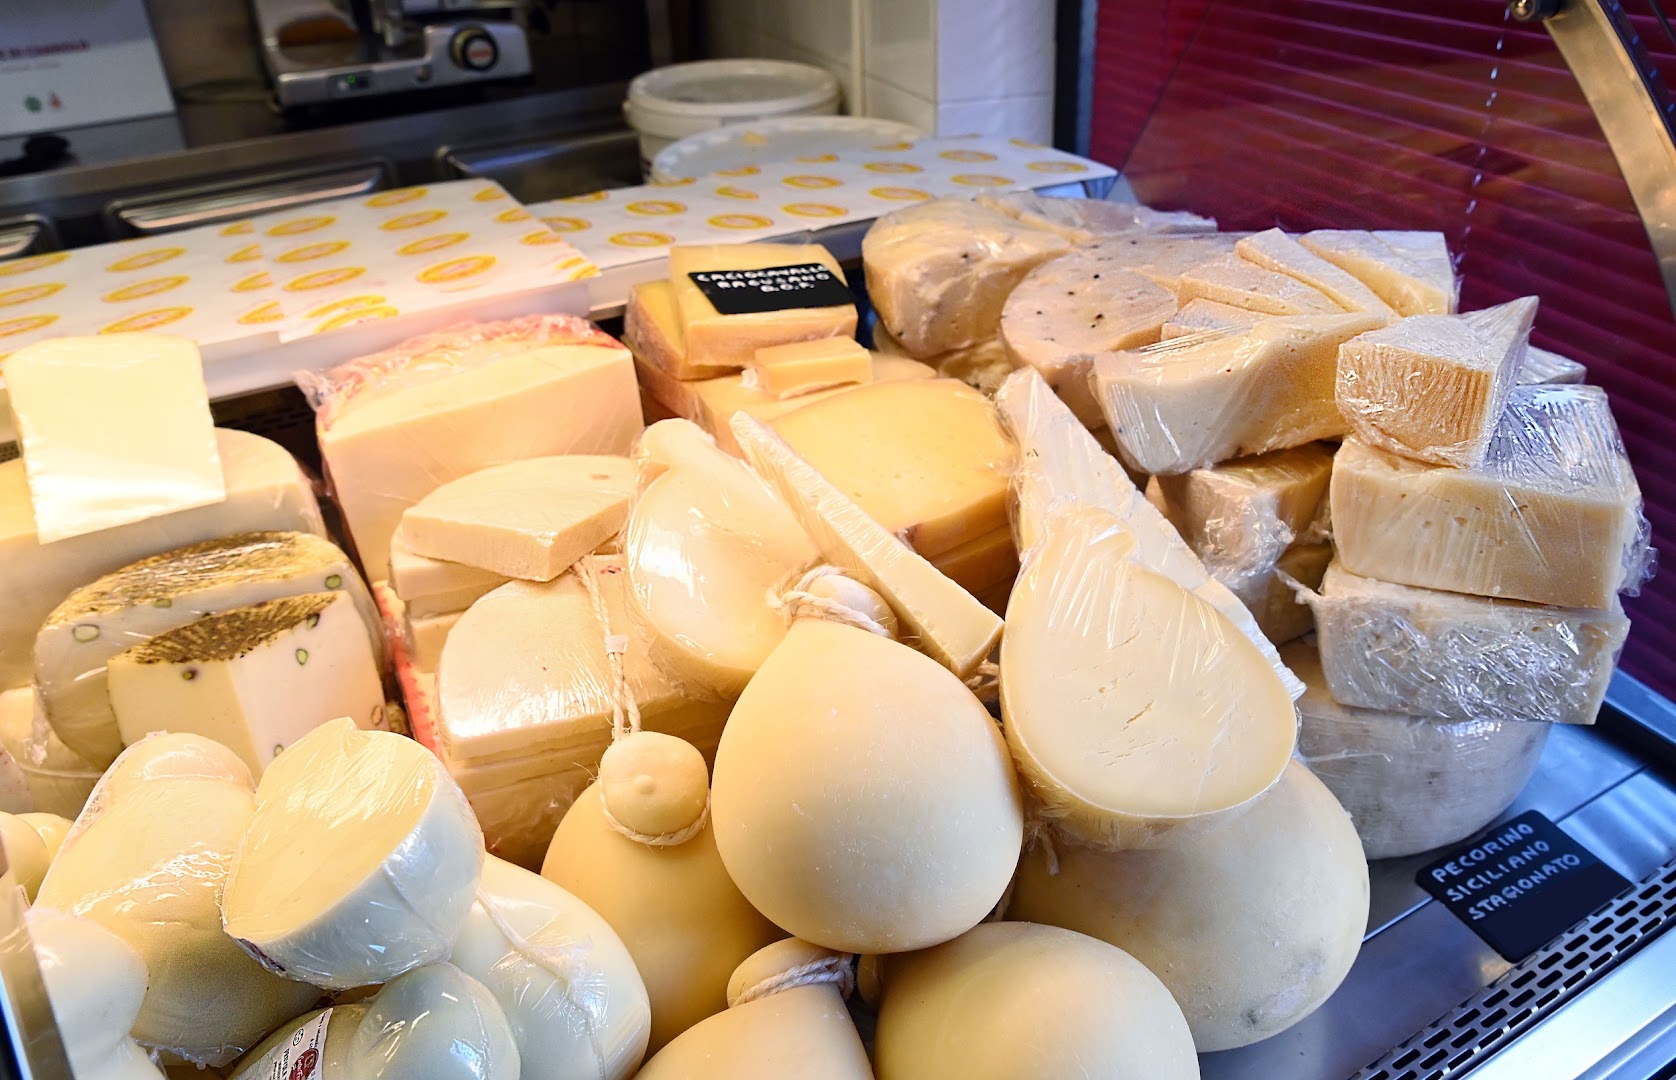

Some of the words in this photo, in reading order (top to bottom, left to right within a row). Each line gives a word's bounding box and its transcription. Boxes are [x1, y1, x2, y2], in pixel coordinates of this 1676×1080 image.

[1431, 823, 1534, 883] PECORINO
[1446, 840, 1550, 901] SICILIANO
[1468, 854, 1580, 920] STAGIONATO
